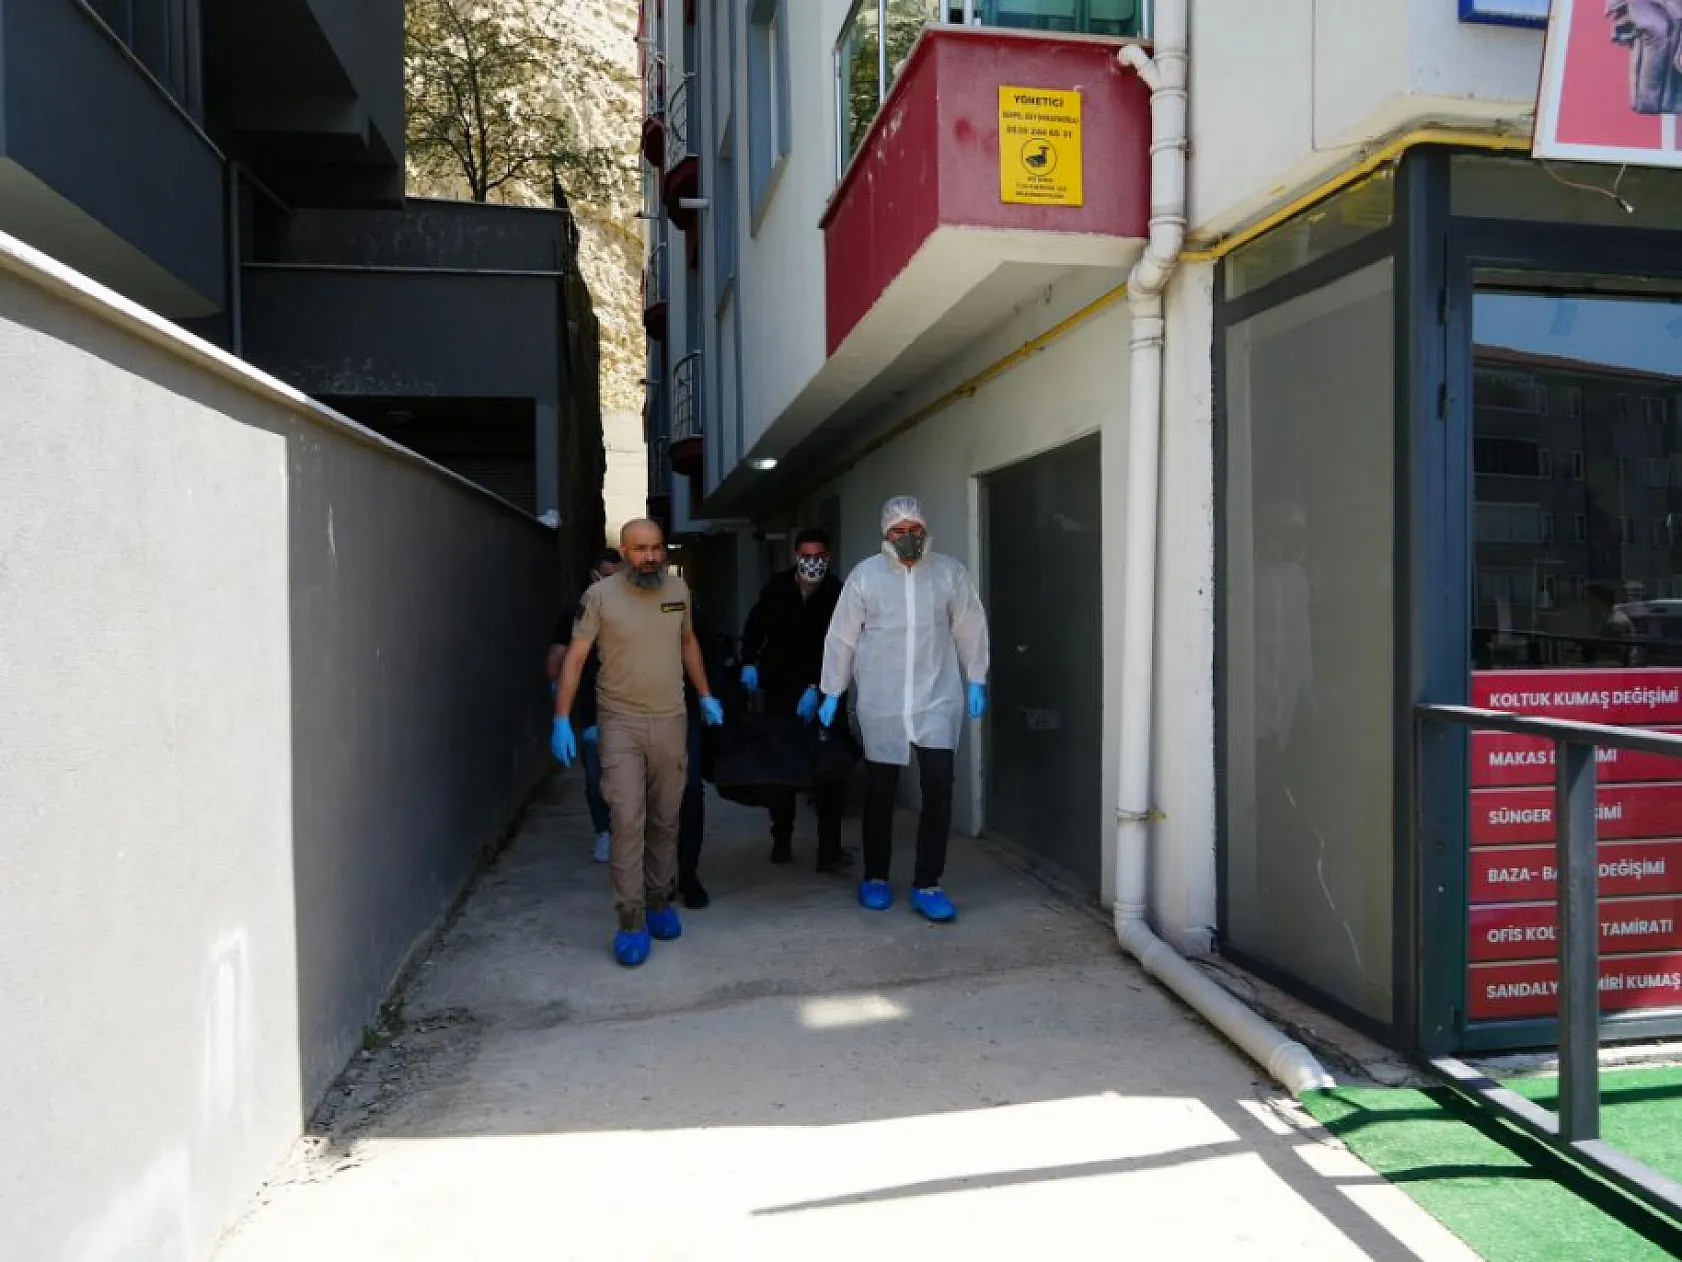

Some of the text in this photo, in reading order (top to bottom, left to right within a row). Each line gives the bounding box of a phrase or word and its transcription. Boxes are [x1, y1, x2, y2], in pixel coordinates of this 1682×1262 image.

[1489, 686, 1679, 709] KOLTUK KUMAŞ DEĞİŞİMİ
[1489, 750, 1547, 766] MAKAS
[1488, 807, 1551, 825] SÜNGER
[1598, 857, 1666, 880] DEĞİŞİMİ
[1487, 917, 1674, 943] OFİS KOL TAMİRATI
[1486, 980, 1559, 999] SANDALY
[1626, 972, 1681, 991] KUMAŞ
